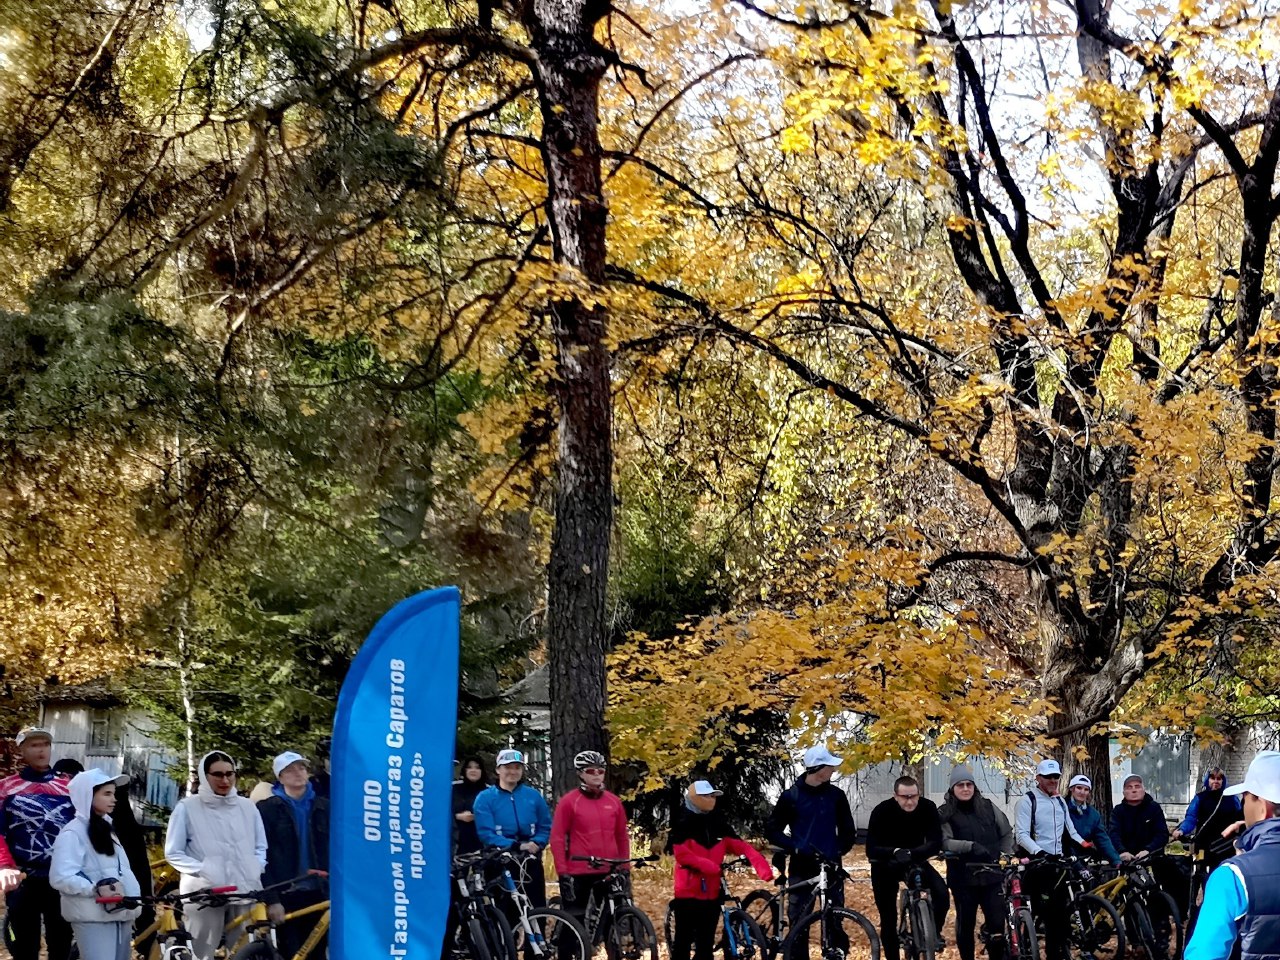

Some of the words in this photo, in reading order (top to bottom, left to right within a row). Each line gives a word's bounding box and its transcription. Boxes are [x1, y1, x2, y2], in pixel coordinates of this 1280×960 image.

[386, 658, 408, 749] Саратов
[363, 779, 382, 842] ОППО
[388, 755, 406, 854] трансгаз
[406, 752, 426, 879] профсоюз»
